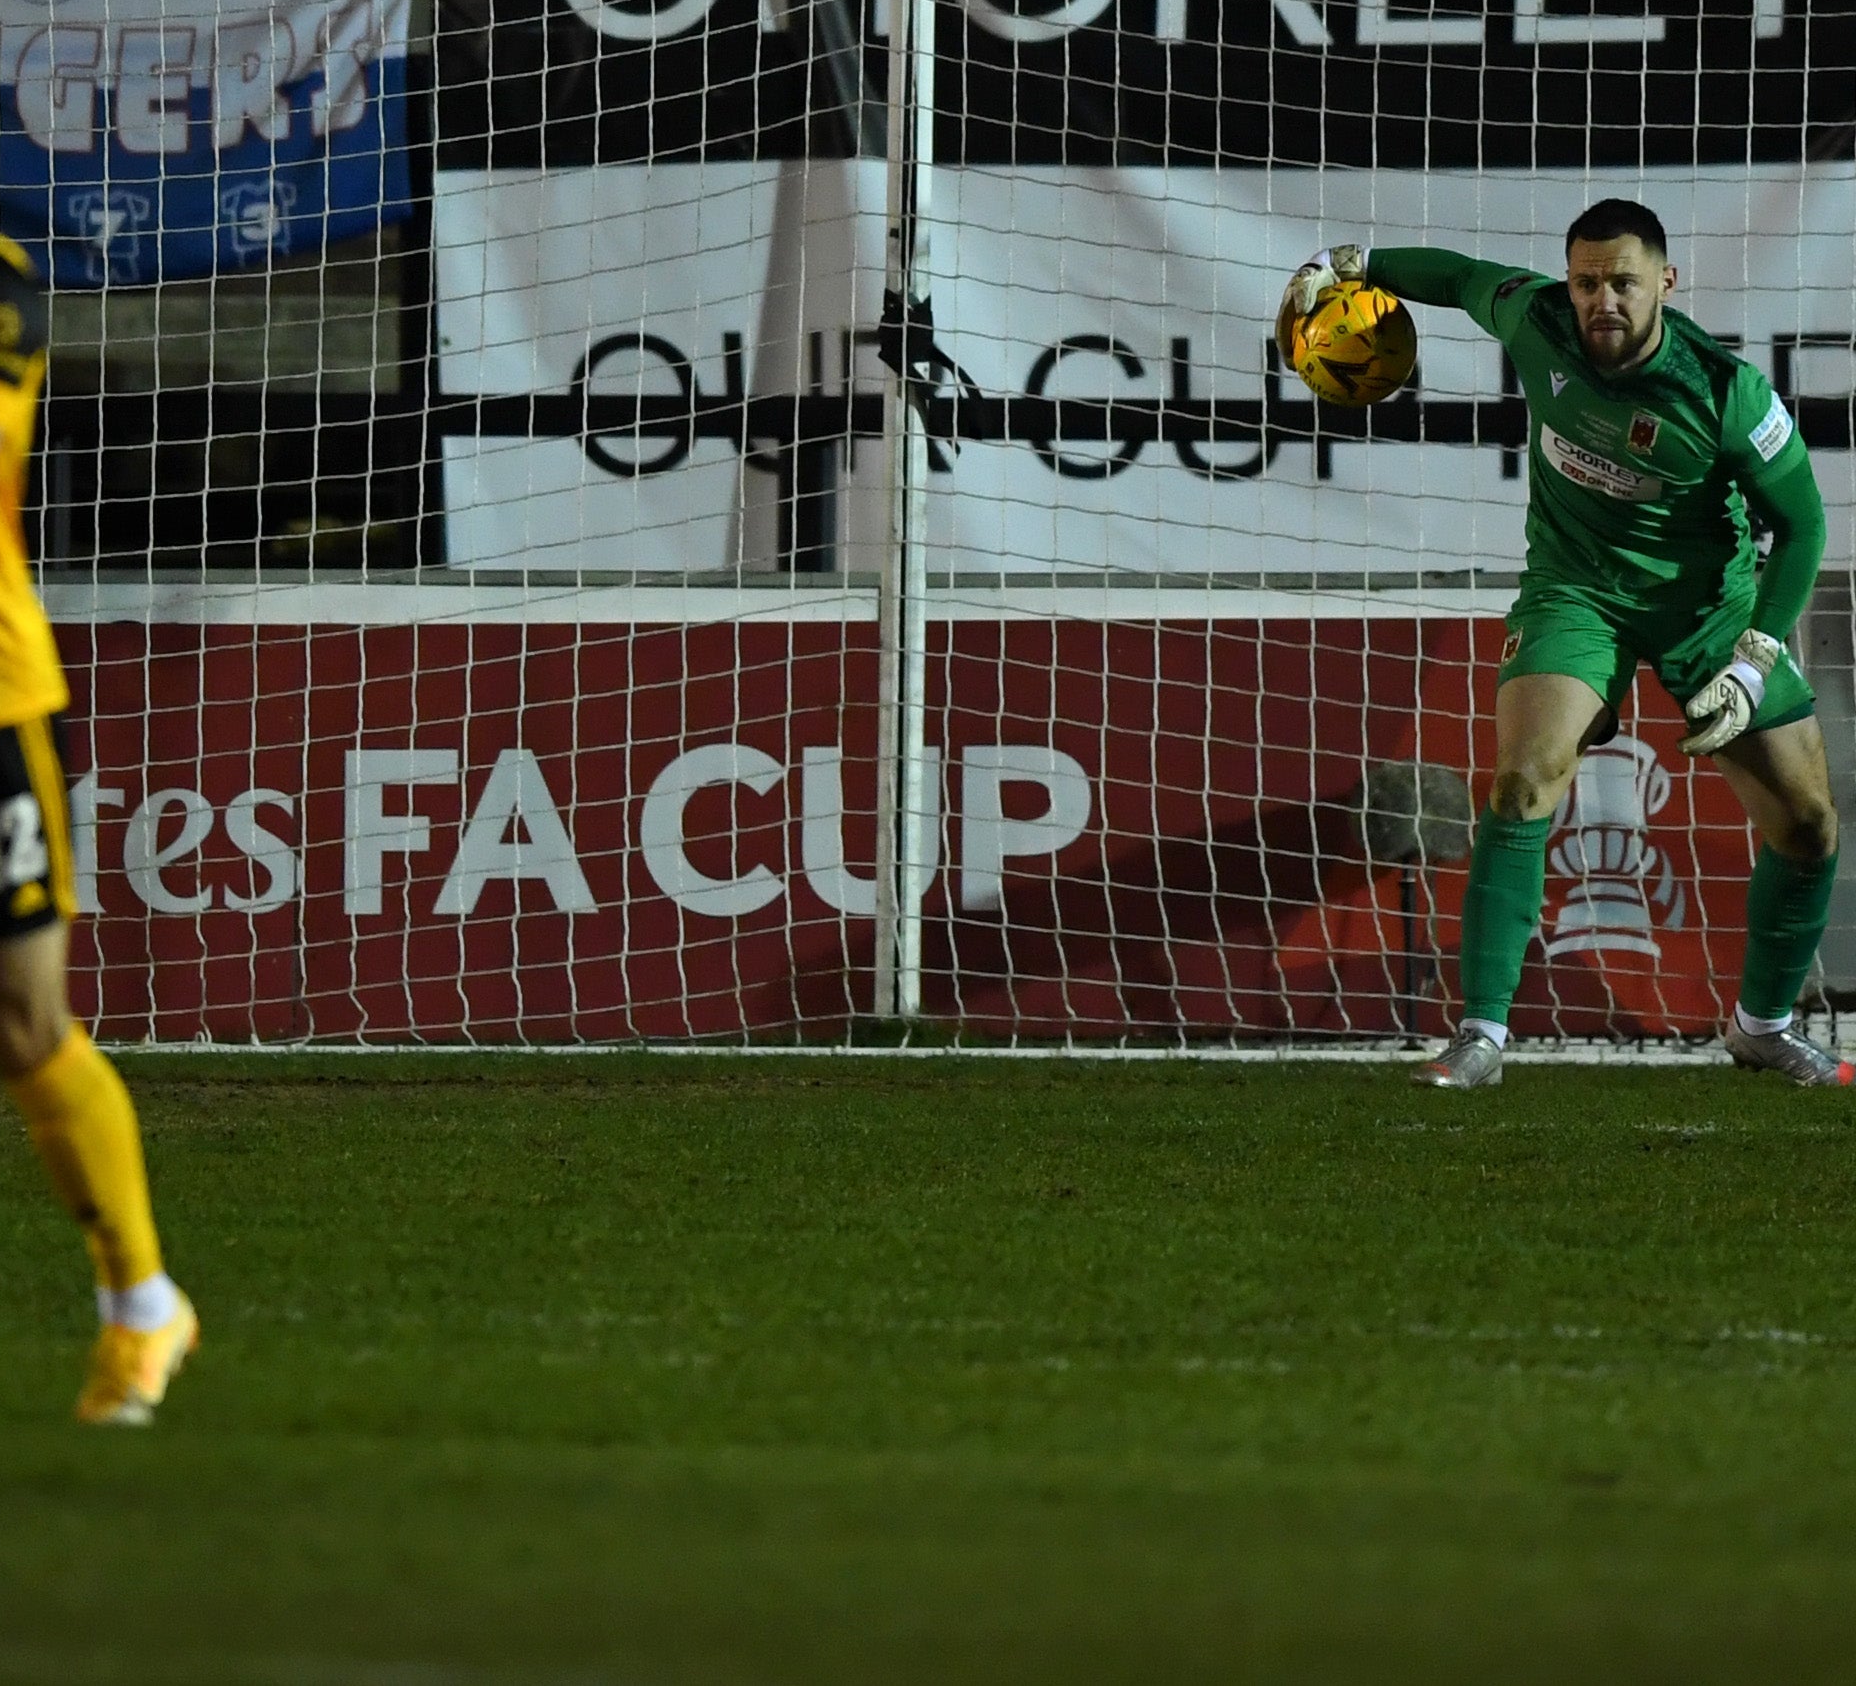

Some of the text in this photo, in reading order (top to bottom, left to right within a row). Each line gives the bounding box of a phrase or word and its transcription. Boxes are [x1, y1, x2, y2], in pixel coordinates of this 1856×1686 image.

[1554, 435, 1645, 486] CHORLEY
[343, 747, 598, 915] FA
[639, 742, 1094, 917] CUP
